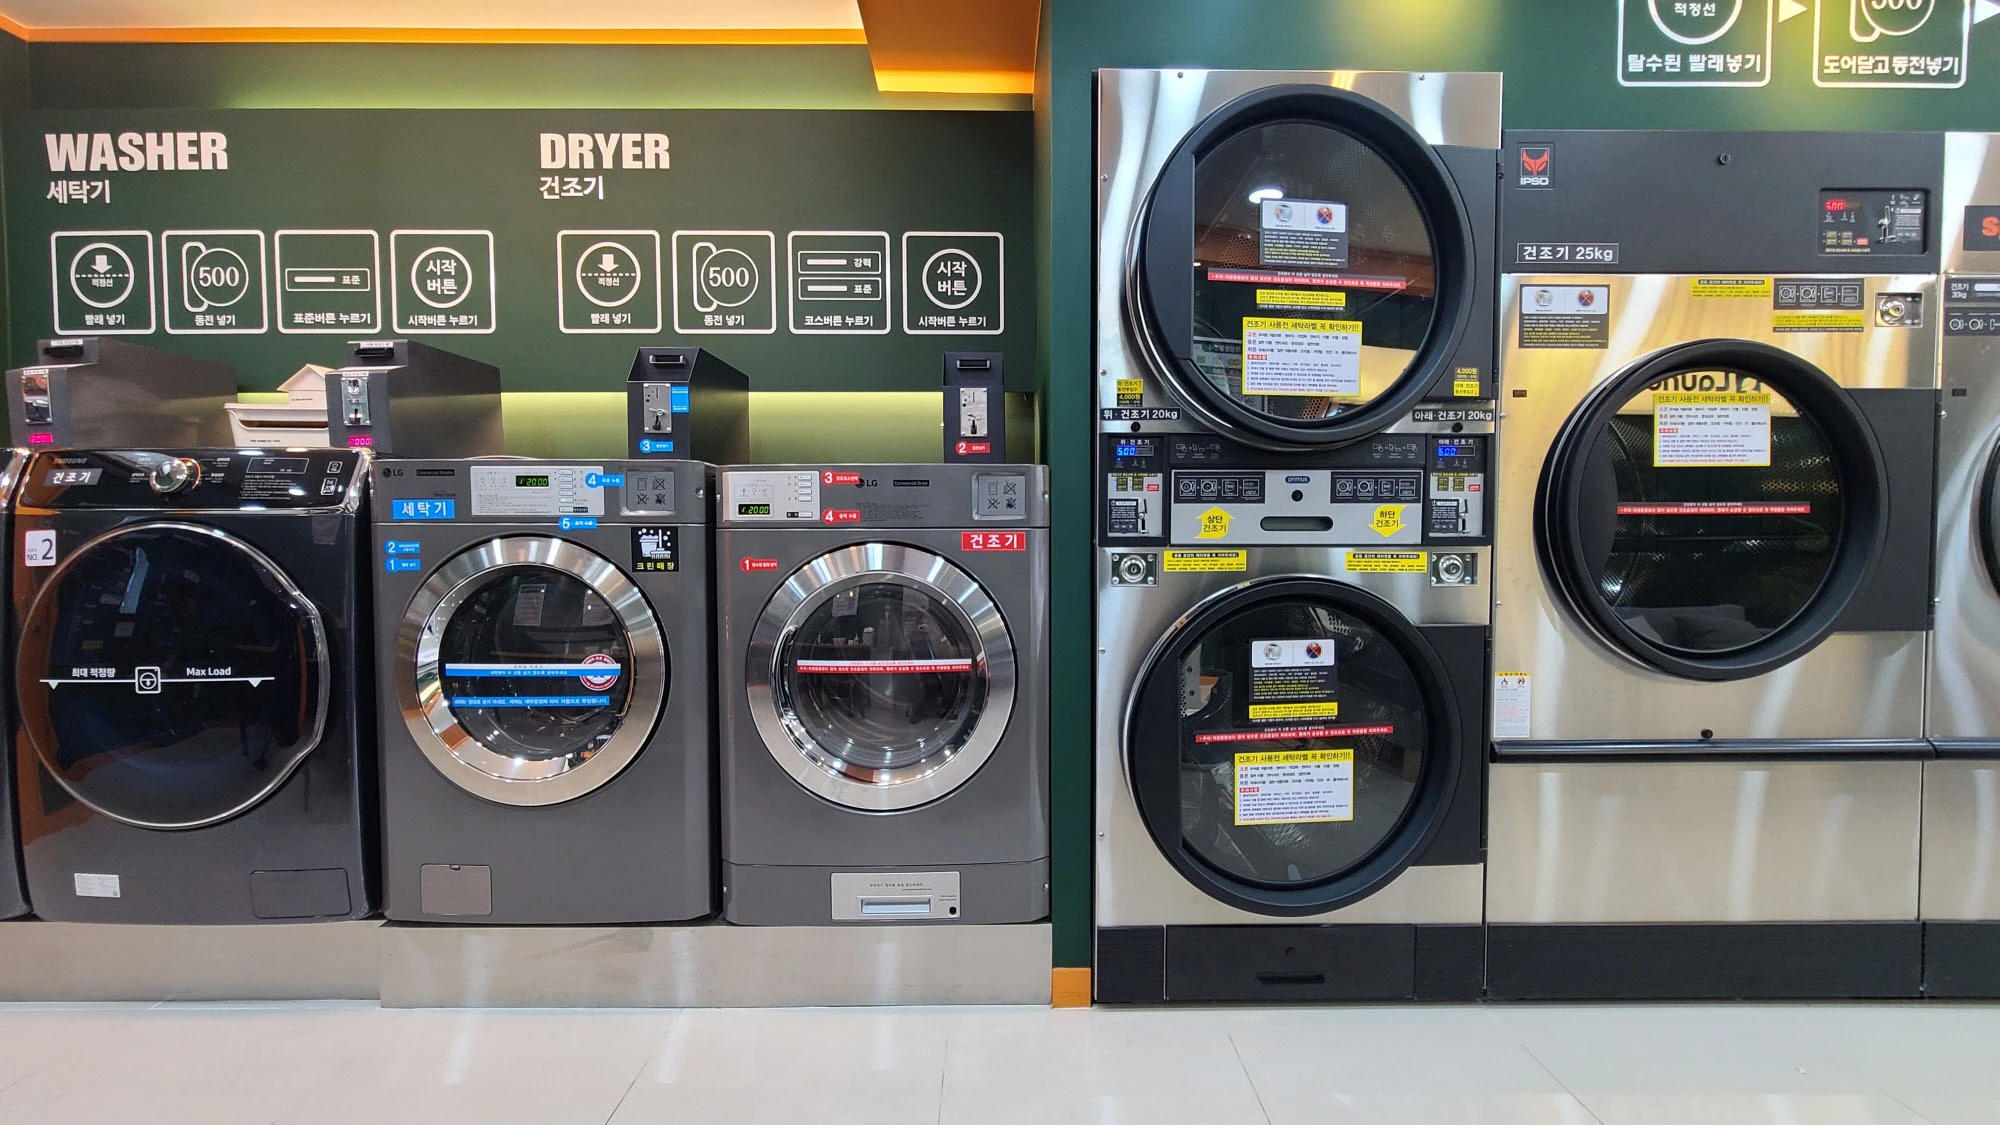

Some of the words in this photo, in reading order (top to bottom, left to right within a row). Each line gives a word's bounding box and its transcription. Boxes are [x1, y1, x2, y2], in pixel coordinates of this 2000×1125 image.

[1674, 3, 1716, 17] 적정선
[1628, 54, 1681, 73] 탈수된
[1688, 53, 1761, 73] 빨래넣기
[1823, 55, 1890, 75] 도어닫고
[1892, 55, 1959, 76] 동전넣기
[45, 132, 228, 171] WASHER
[539, 132, 671, 170] DRYER
[1520, 177, 1549, 186] IPSO
[46, 180, 111, 204] 세탁기
[539, 176, 605, 200] 건조기
[1981, 216, 2000, 239] S
[1523, 246, 1569, 260] 건조기
[1575, 246, 1613, 261] 25kg
[425, 259, 457, 276] 시작
[853, 257, 872, 268] 강력
[936, 259, 967, 277] 시작
[91, 278, 113, 288] 적정선
[199, 266, 239, 288] 500
[342, 275, 360, 285] 표준
[598, 277, 620, 286] 적정선
[708, 266, 750, 288] 500
[426, 278, 458, 295] 버튼
[853, 284, 872, 294] 표준
[937, 279, 968, 297] 버튼
[85, 314, 103, 326] 빨래
[105, 313, 126, 326] 넣기
[195, 314, 213, 327] 동전
[216, 313, 236, 327] 넣기
[293, 312, 336, 325] 표준버튼
[339, 312, 371, 325] 누르기
[407, 314, 446, 327] 시작버튼
[449, 314, 478, 327] 누르기
[590, 313, 610, 325] 빨래
[612, 313, 631, 325] 넣기
[703, 314, 723, 327] 동전
[725, 314, 745, 327] 넣기
[804, 315, 842, 327] 코스버튼
[844, 315, 874, 327] 누르기
[918, 315, 956, 328] 시작버튼
[958, 315, 987, 327] 누르기
[1246, 320, 1267, 328] 건조기
[1269, 321, 1289, 329] 사용전
[1291, 322, 1317, 331] 세탁라벨
[1152, 409, 1178, 420] 20kg
[1467, 410, 1492, 421] 20kg
[643, 441, 650, 450] 3
[959, 443, 966, 453] 2
[1117, 446, 1136, 456] 500
[53, 471, 91, 484] 건조기
[588, 474, 597, 485] 4
[825, 472, 833, 483] 3
[402, 501, 446, 516] 세탁기
[1379, 510, 1395, 519] 하단
[825, 510, 833, 521] 4
[1207, 515, 1223, 524] 상단
[563, 518, 570, 528] 5
[1203, 524, 1227, 533] 건조기
[1375, 519, 1399, 528] 건조기
[970, 534, 1018, 548] 건조기
[42, 538, 54, 560] 2
[388, 542, 396, 553] 2
[390, 559, 394, 570] 1
[744, 559, 749, 570] 1
[72, 668, 88, 677] 최대
[89, 668, 116, 678] 적정량
[187, 668, 205, 676] Max
[208, 667, 232, 676] Load
[1261, 754, 1280, 762] 사용전
[1282, 753, 1308, 761] 세탁라벨
